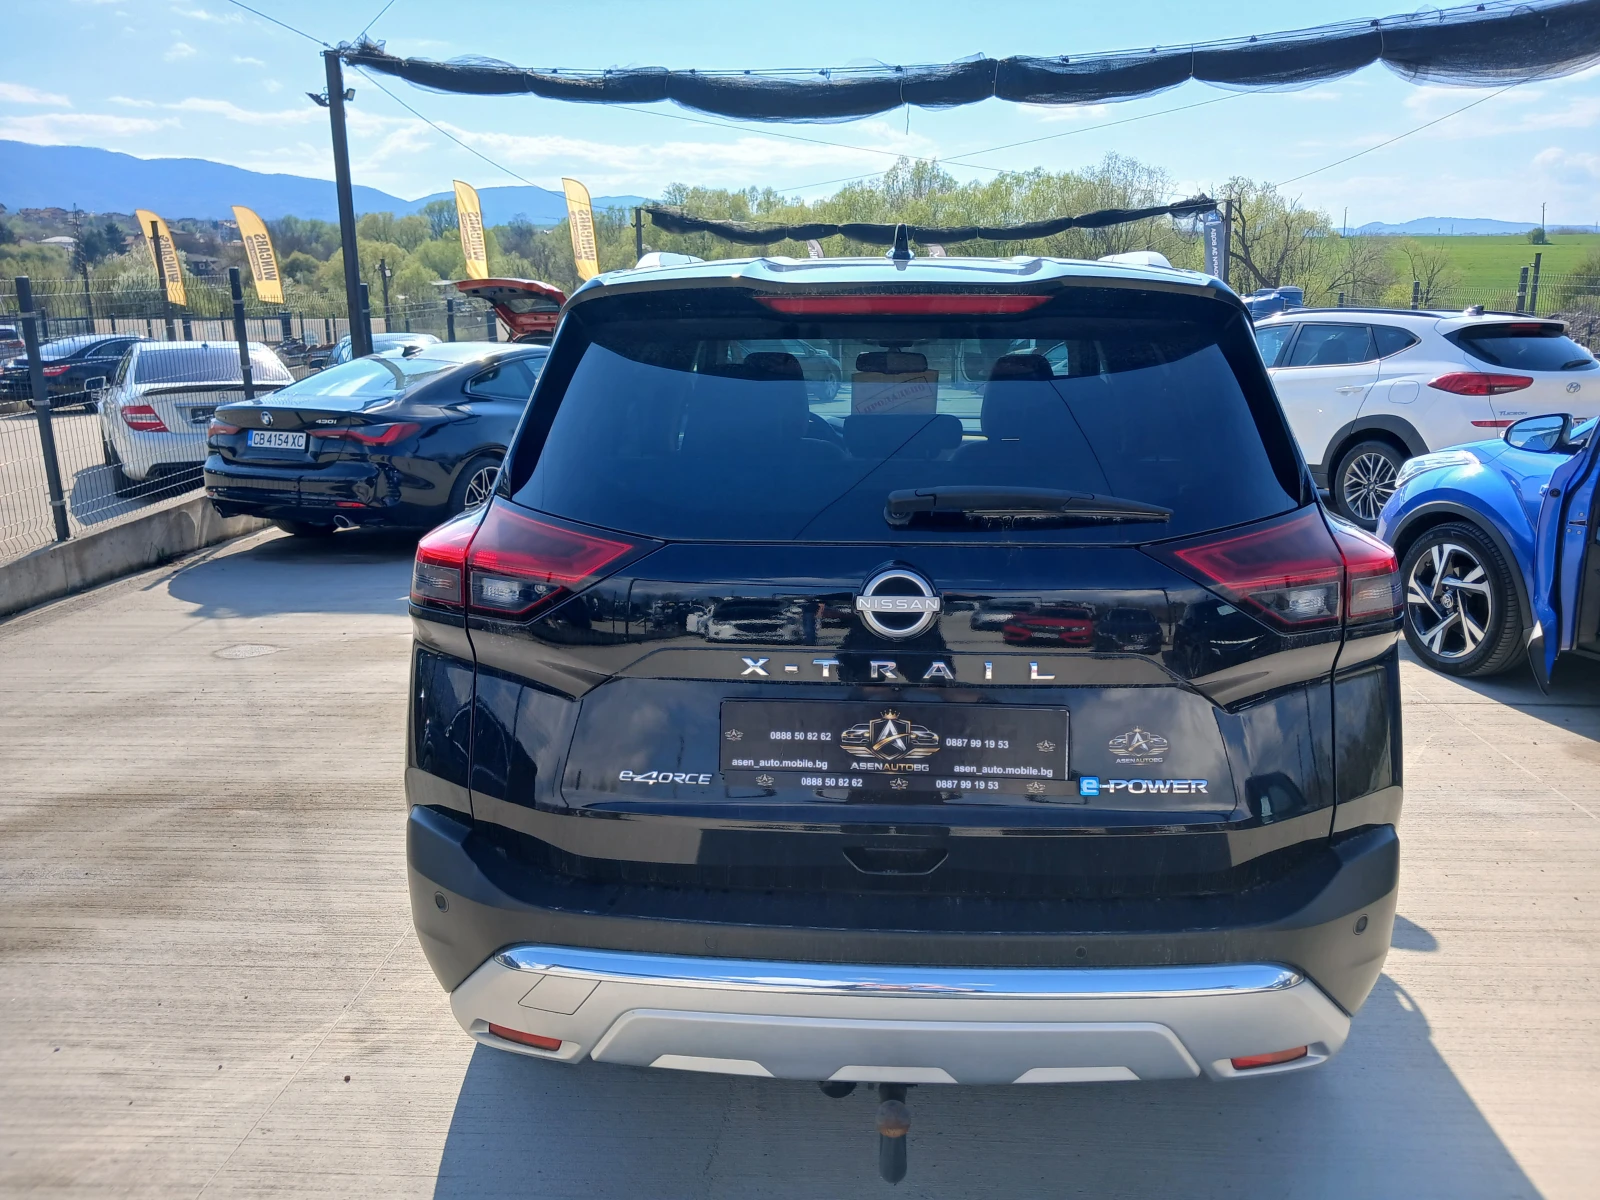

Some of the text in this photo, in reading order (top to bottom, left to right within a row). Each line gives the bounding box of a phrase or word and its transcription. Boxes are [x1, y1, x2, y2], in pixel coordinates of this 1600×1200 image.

[253, 432, 304, 448] CB 4154 XC
[859, 598, 938, 610] NISSAN
[740, 656, 1056, 681] X-TRAIL
[770, 731, 832, 741] 0888 50 82 62
[945, 738, 1009, 749] 0887 99 19 53
[731, 758, 829, 770] asen_auto.mobile.bg
[850, 762, 930, 772] ASENAUTOBG
[953, 764, 1054, 778] asen_auto.mobile.bg
[801, 777, 863, 788] 0888 50 82 62
[935, 780, 999, 790] 0887 99 19 53
[1080, 777, 1209, 795] e-POWER
